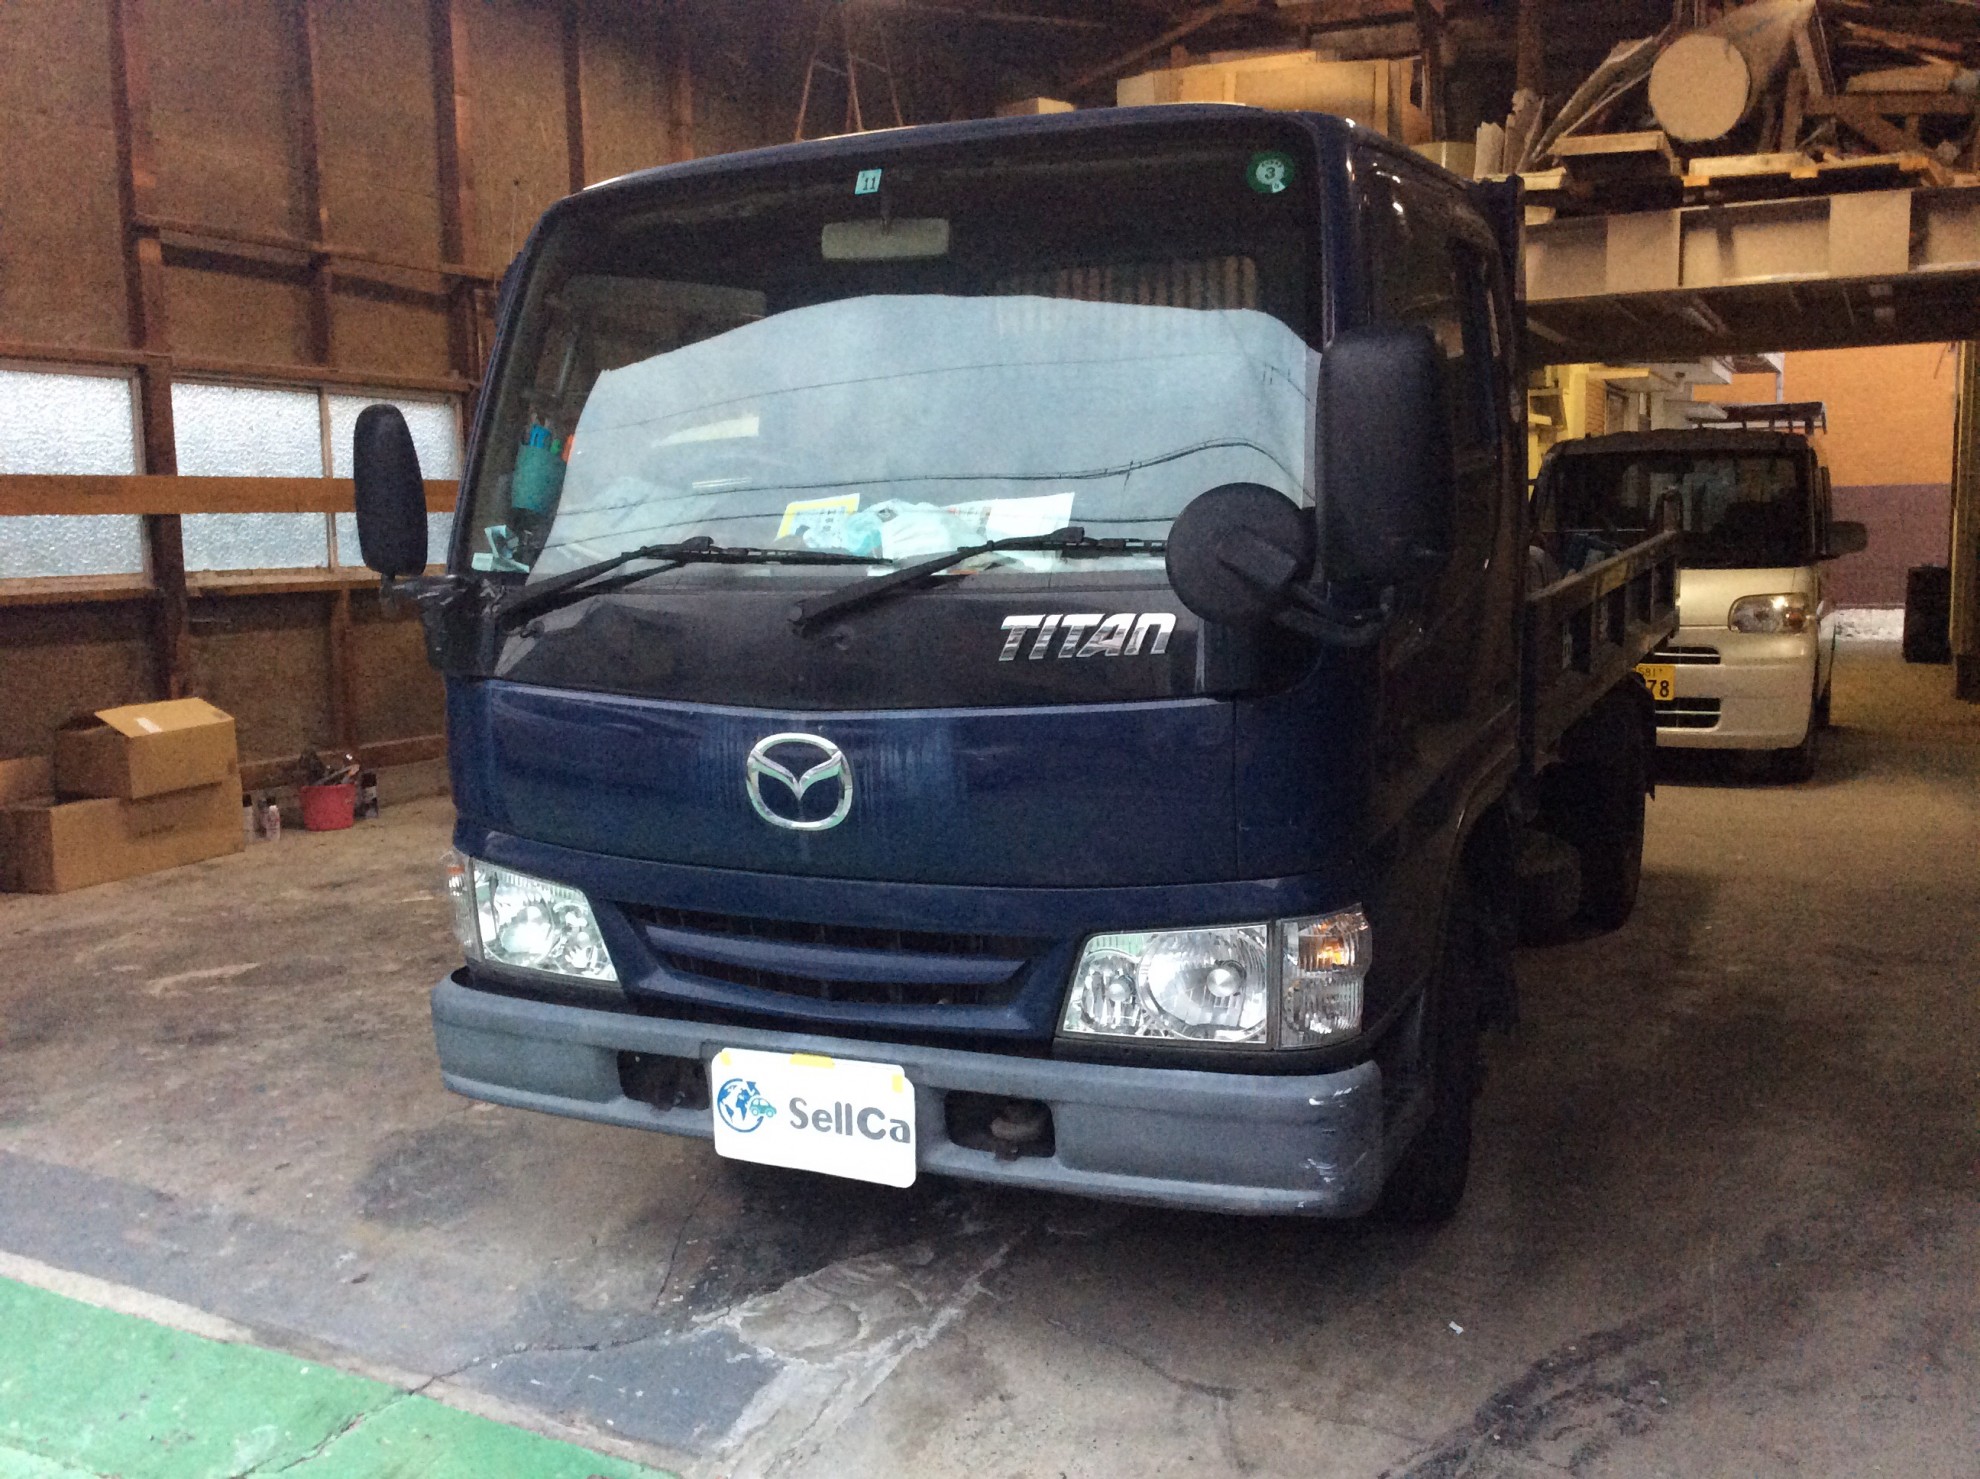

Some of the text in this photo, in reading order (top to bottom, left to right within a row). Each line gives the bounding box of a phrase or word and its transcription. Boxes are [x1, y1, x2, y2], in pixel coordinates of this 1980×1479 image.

[863, 176, 876, 190] 11
[998, 612, 1176, 661] TITAN
[789, 1097, 911, 1144] SellCa
